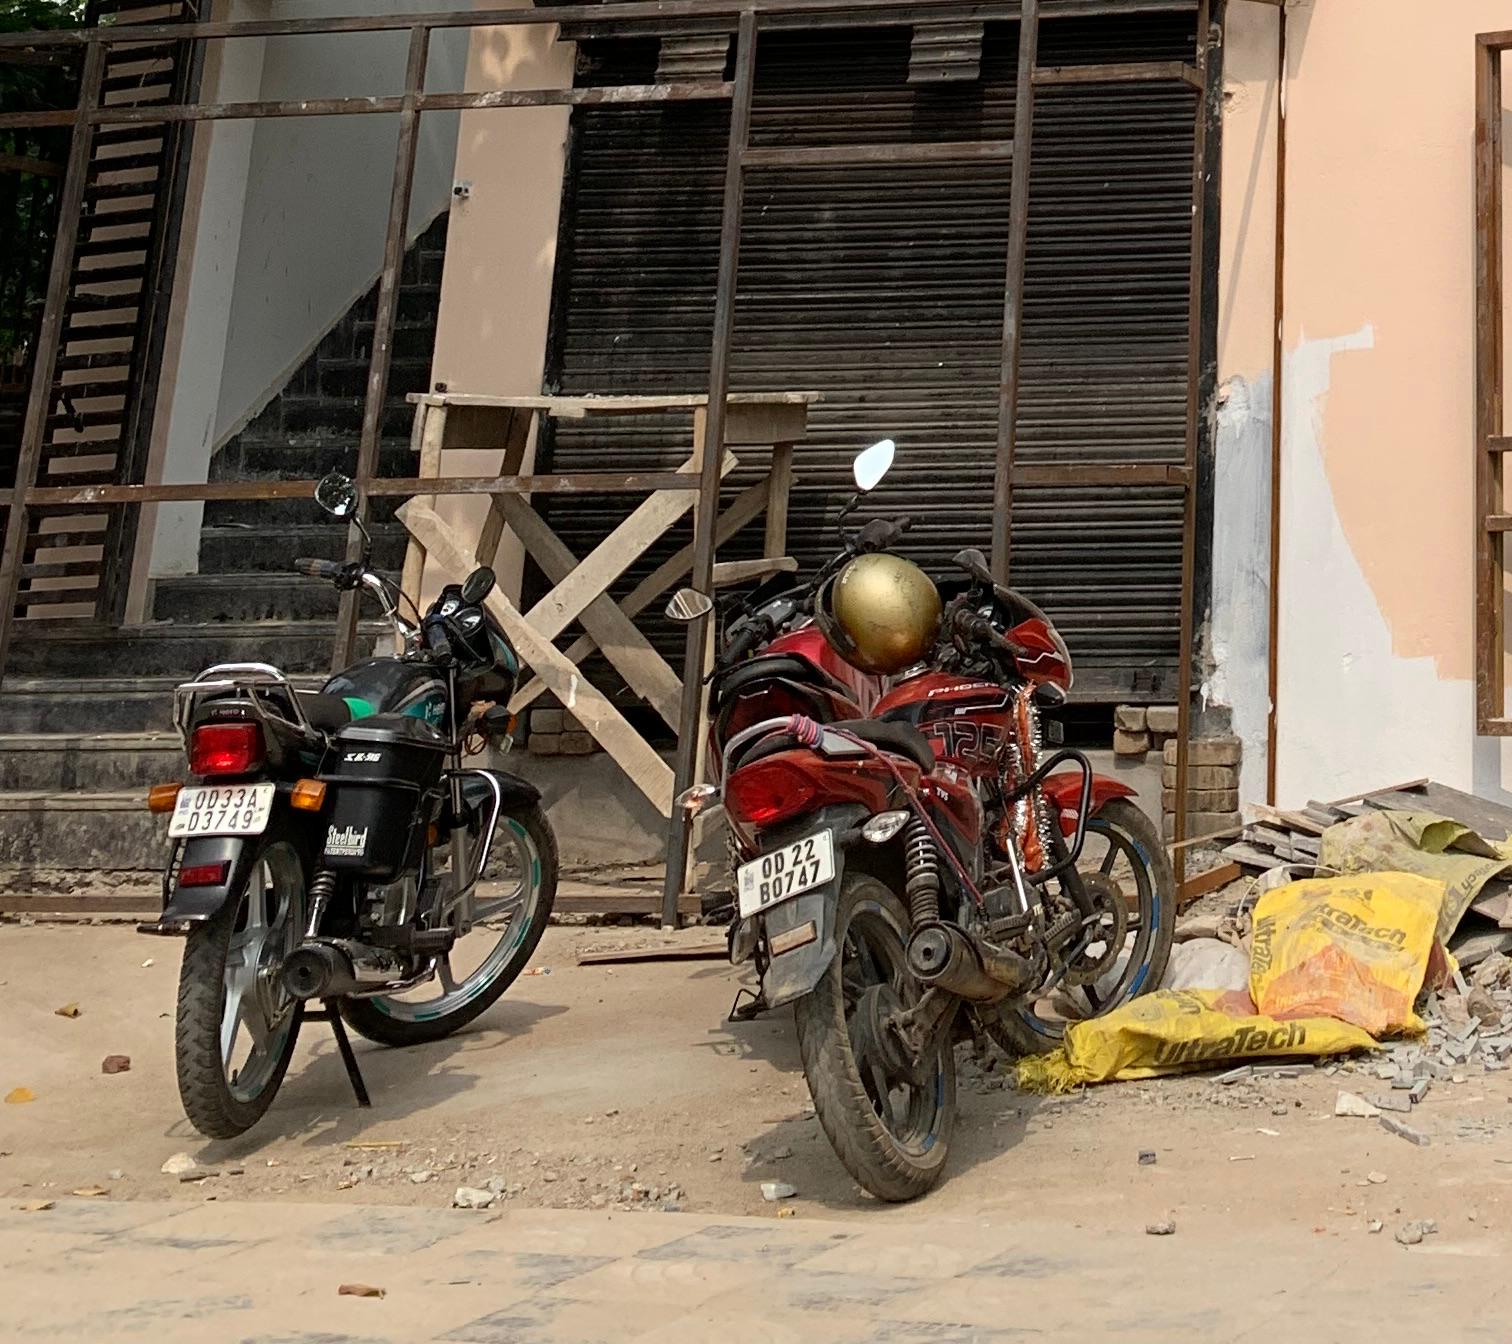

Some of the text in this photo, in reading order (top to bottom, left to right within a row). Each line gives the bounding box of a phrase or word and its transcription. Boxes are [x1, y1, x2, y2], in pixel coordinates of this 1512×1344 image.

[927, 682, 1000, 697] PHOEN
[187, 811, 254, 832] D3749
[326, 824, 369, 847] Steelbird
[791, 839, 816, 868] 22
[1153, 1020, 1307, 1064] UltraTech
